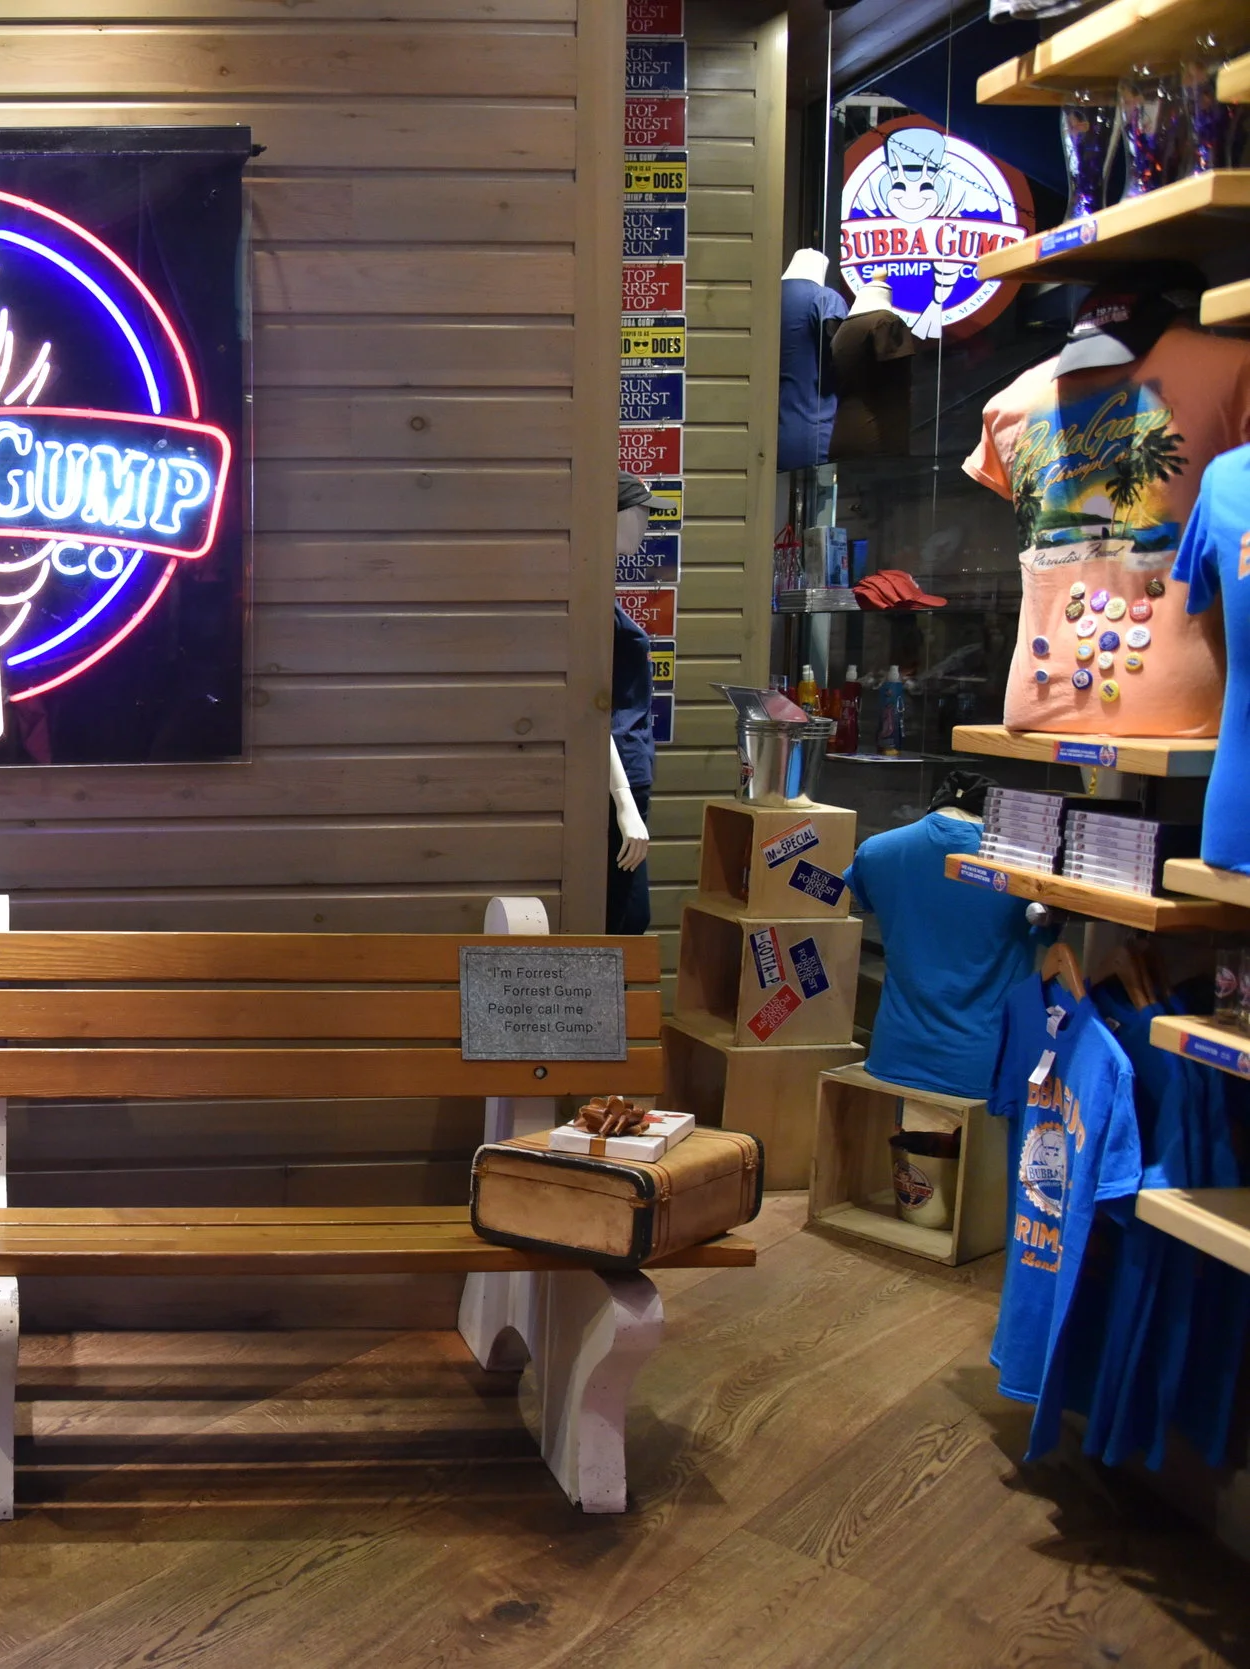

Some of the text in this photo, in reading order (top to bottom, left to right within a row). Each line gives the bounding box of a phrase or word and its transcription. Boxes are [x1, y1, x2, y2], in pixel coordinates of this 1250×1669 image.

[625, 104, 658, 117] TOP
[625, 117, 672, 130] RREST
[625, 130, 657, 144] TOP
[653, 172, 683, 189] DOES
[623, 228, 672, 241] RREST
[840, 226, 929, 262] BUBBA
[623, 269, 656, 283] TOP
[622, 282, 670, 296] RREST
[622, 296, 655, 309] TOP
[651, 337, 681, 354] DOES
[620, 380, 652, 393] RUN
[620, 392, 670, 405] RREST
[619, 406, 652, 419] RUN
[1012, 391, 1173, 492] Bubba Gump
[619, 447, 668, 460] RREST
[51, 539, 124, 580] CO
[616, 554, 666, 568] RREST
[1032, 550, 1082, 571] Paradise
[615, 568, 647, 581] RUN
[616, 596, 647, 609] TOP
[780, 828, 816, 854] SPECIAL
[797, 872, 838, 897] FORREST
[810, 870, 831, 885] RUN
[803, 884, 824, 899] RUN
[757, 940, 777, 974] GOTTA
[797, 947, 819, 990] FORREST
[808, 955, 821, 976] RUN
[795, 963, 807, 983] RUN
[503, 984, 551, 996] Forrest
[488, 1003, 584, 1017] People call me
[756, 993, 791, 1032] FORREST
[504, 1021, 551, 1032] Forrest
[1028, 1166, 1060, 1181] BUBBA
